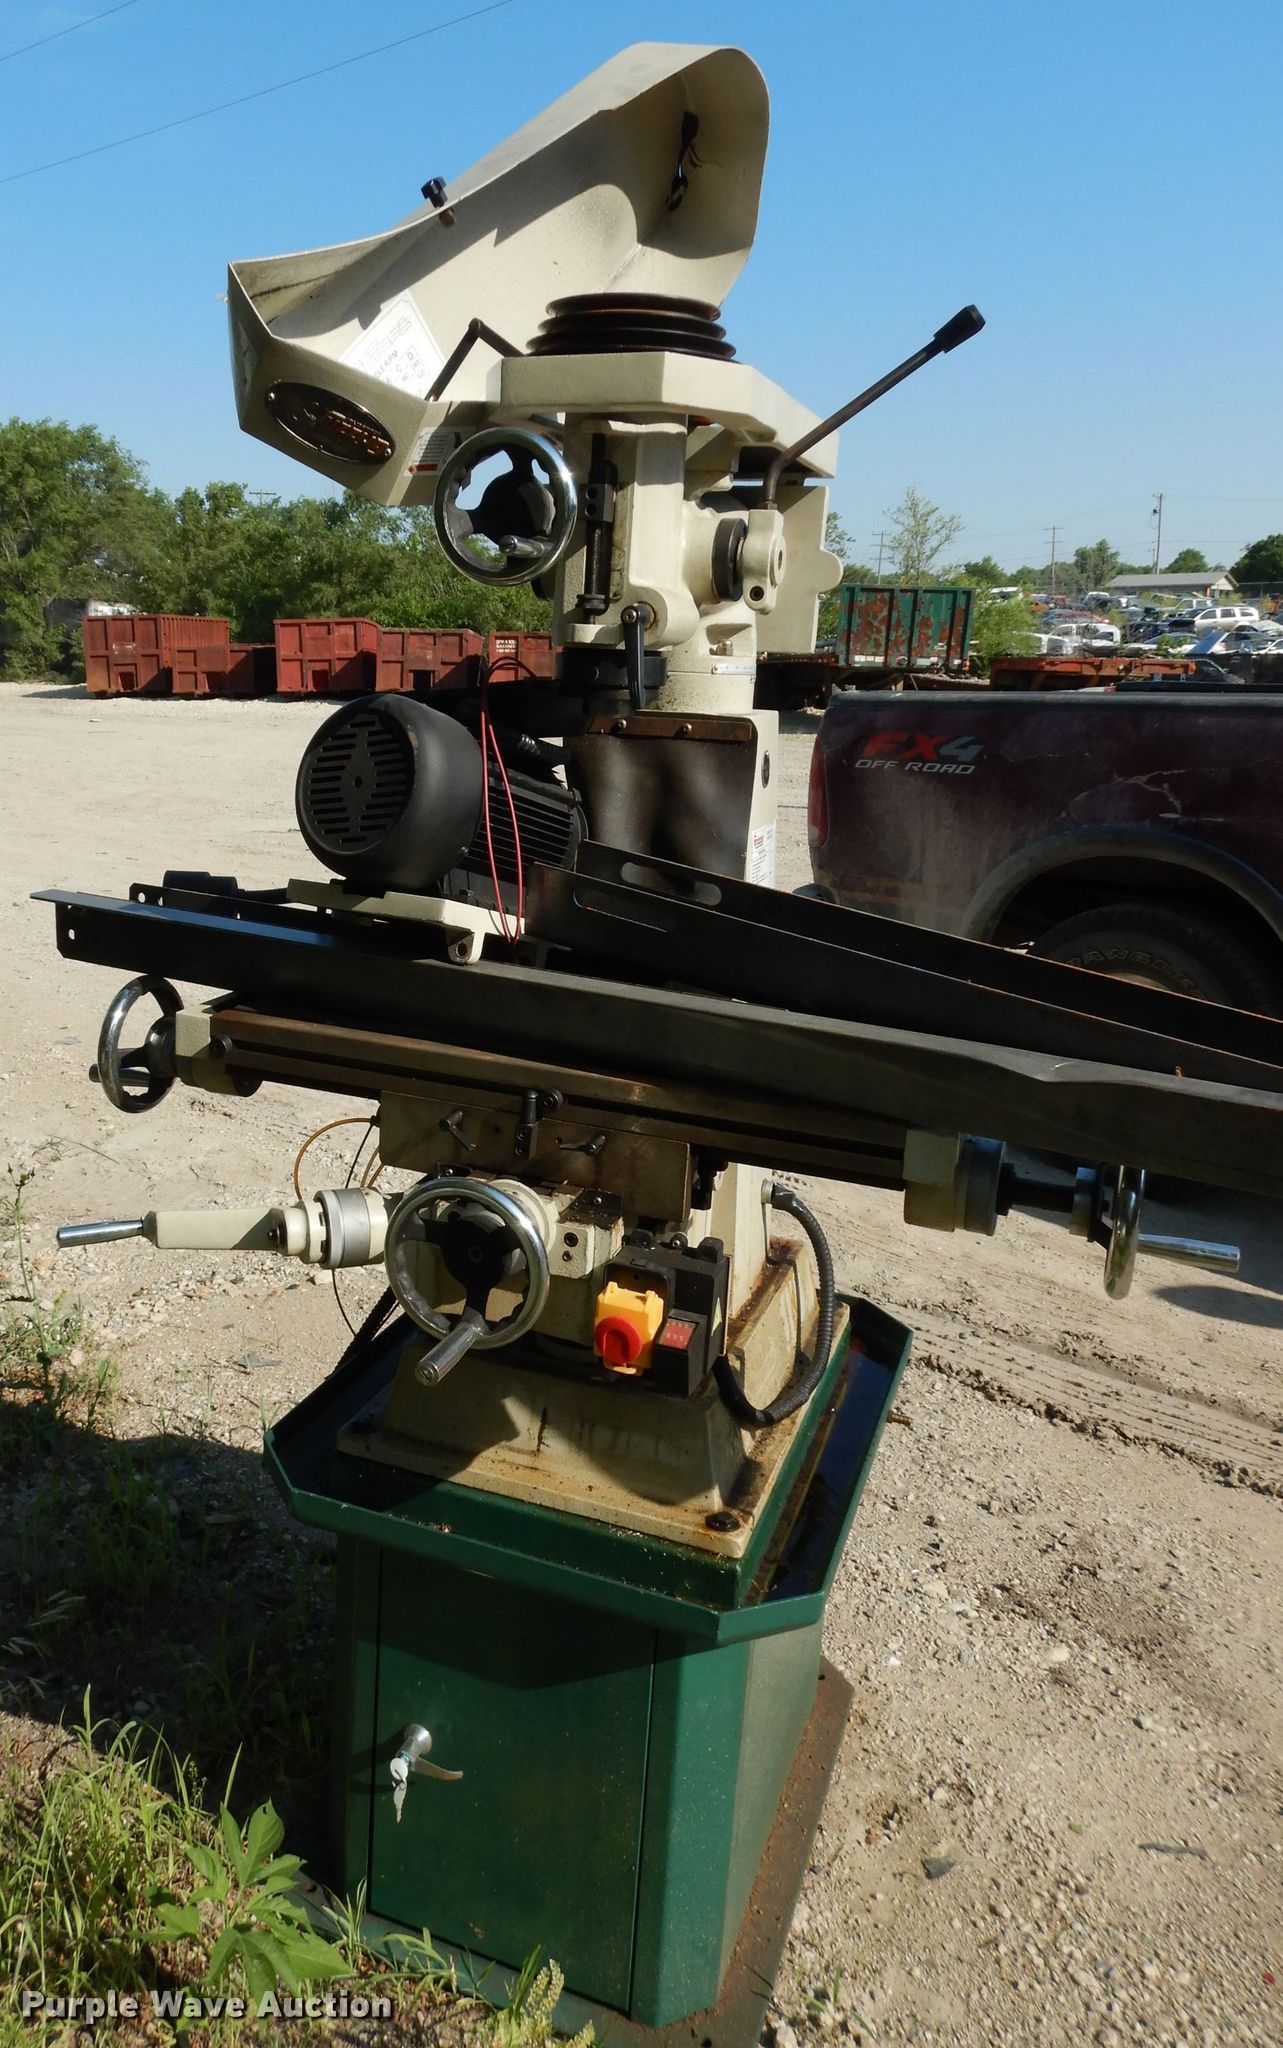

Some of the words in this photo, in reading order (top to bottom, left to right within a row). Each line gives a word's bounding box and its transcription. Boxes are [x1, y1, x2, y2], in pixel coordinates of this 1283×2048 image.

[864, 733, 984, 762] FX4
[854, 759, 899, 769] OFF
[904, 762, 976, 774] ROAD
